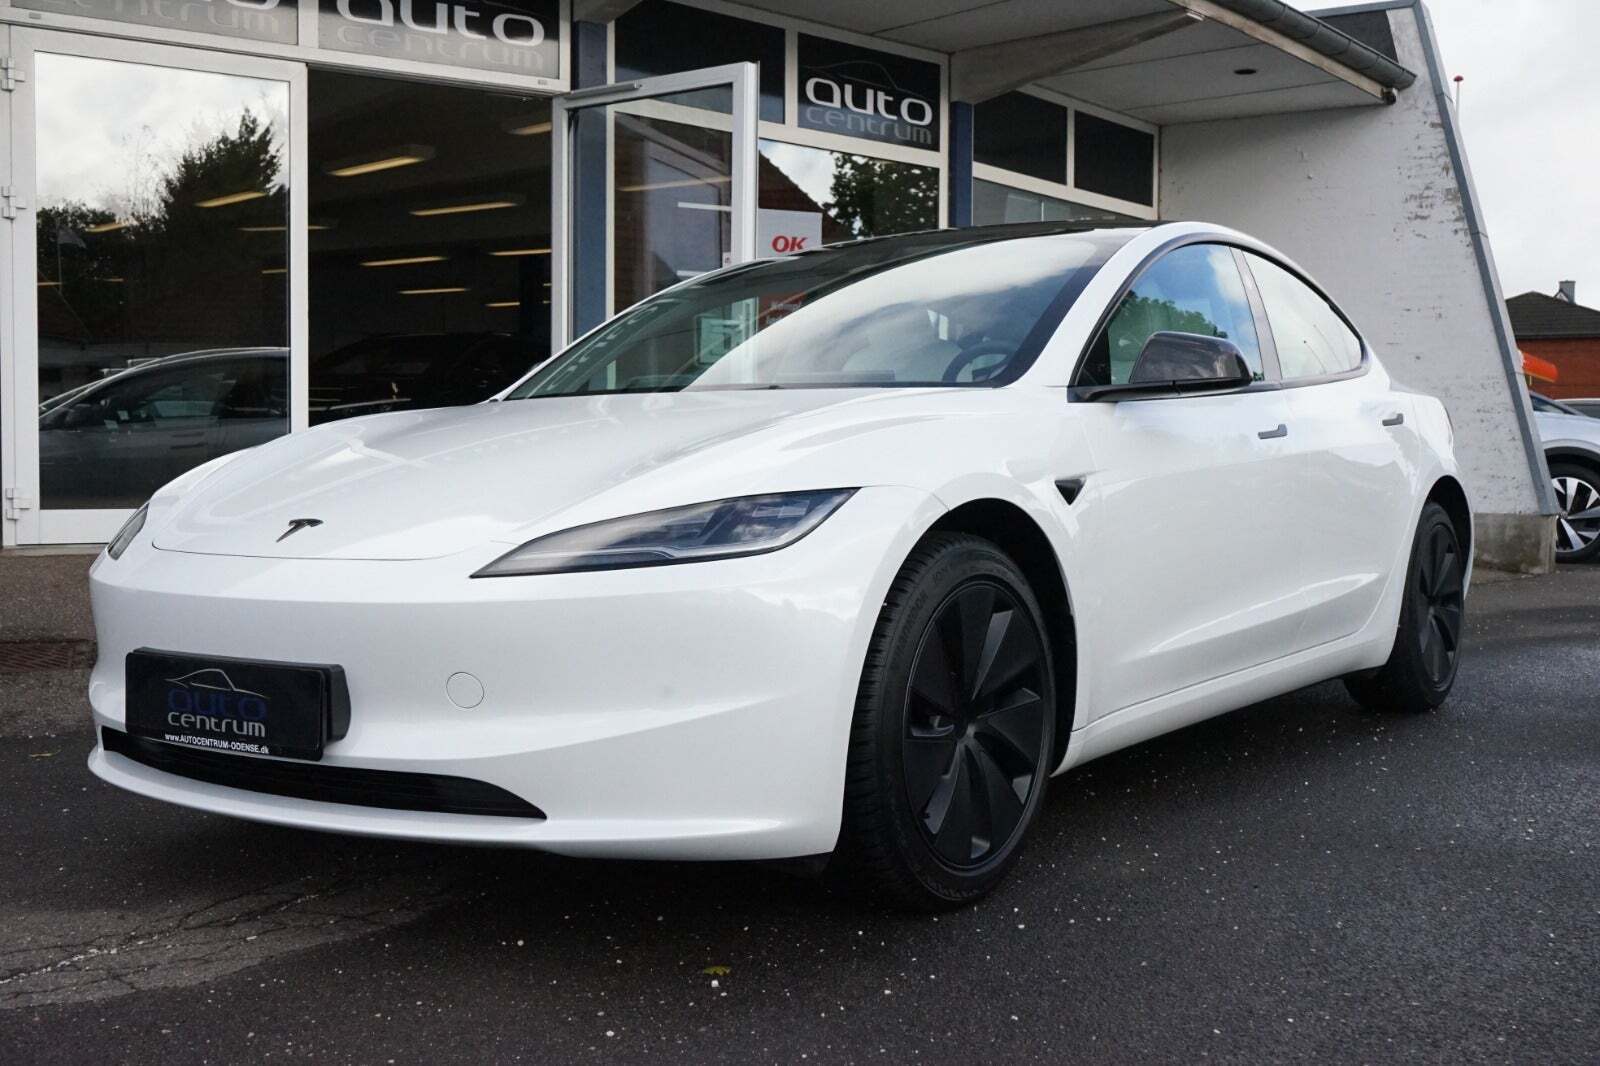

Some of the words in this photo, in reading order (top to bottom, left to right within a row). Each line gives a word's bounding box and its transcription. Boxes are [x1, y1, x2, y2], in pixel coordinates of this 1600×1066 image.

[337, 0, 545, 46] auto
[337, 24, 544, 71] centrum
[805, 77, 933, 126] auto
[805, 106, 932, 145] centrum
[772, 235, 808, 253] OK
[167, 687, 267, 720] auto
[168, 711, 266, 737] centrum
[164, 733, 270, 754] www.AUTOCENTRUM-ODENSE.dk
